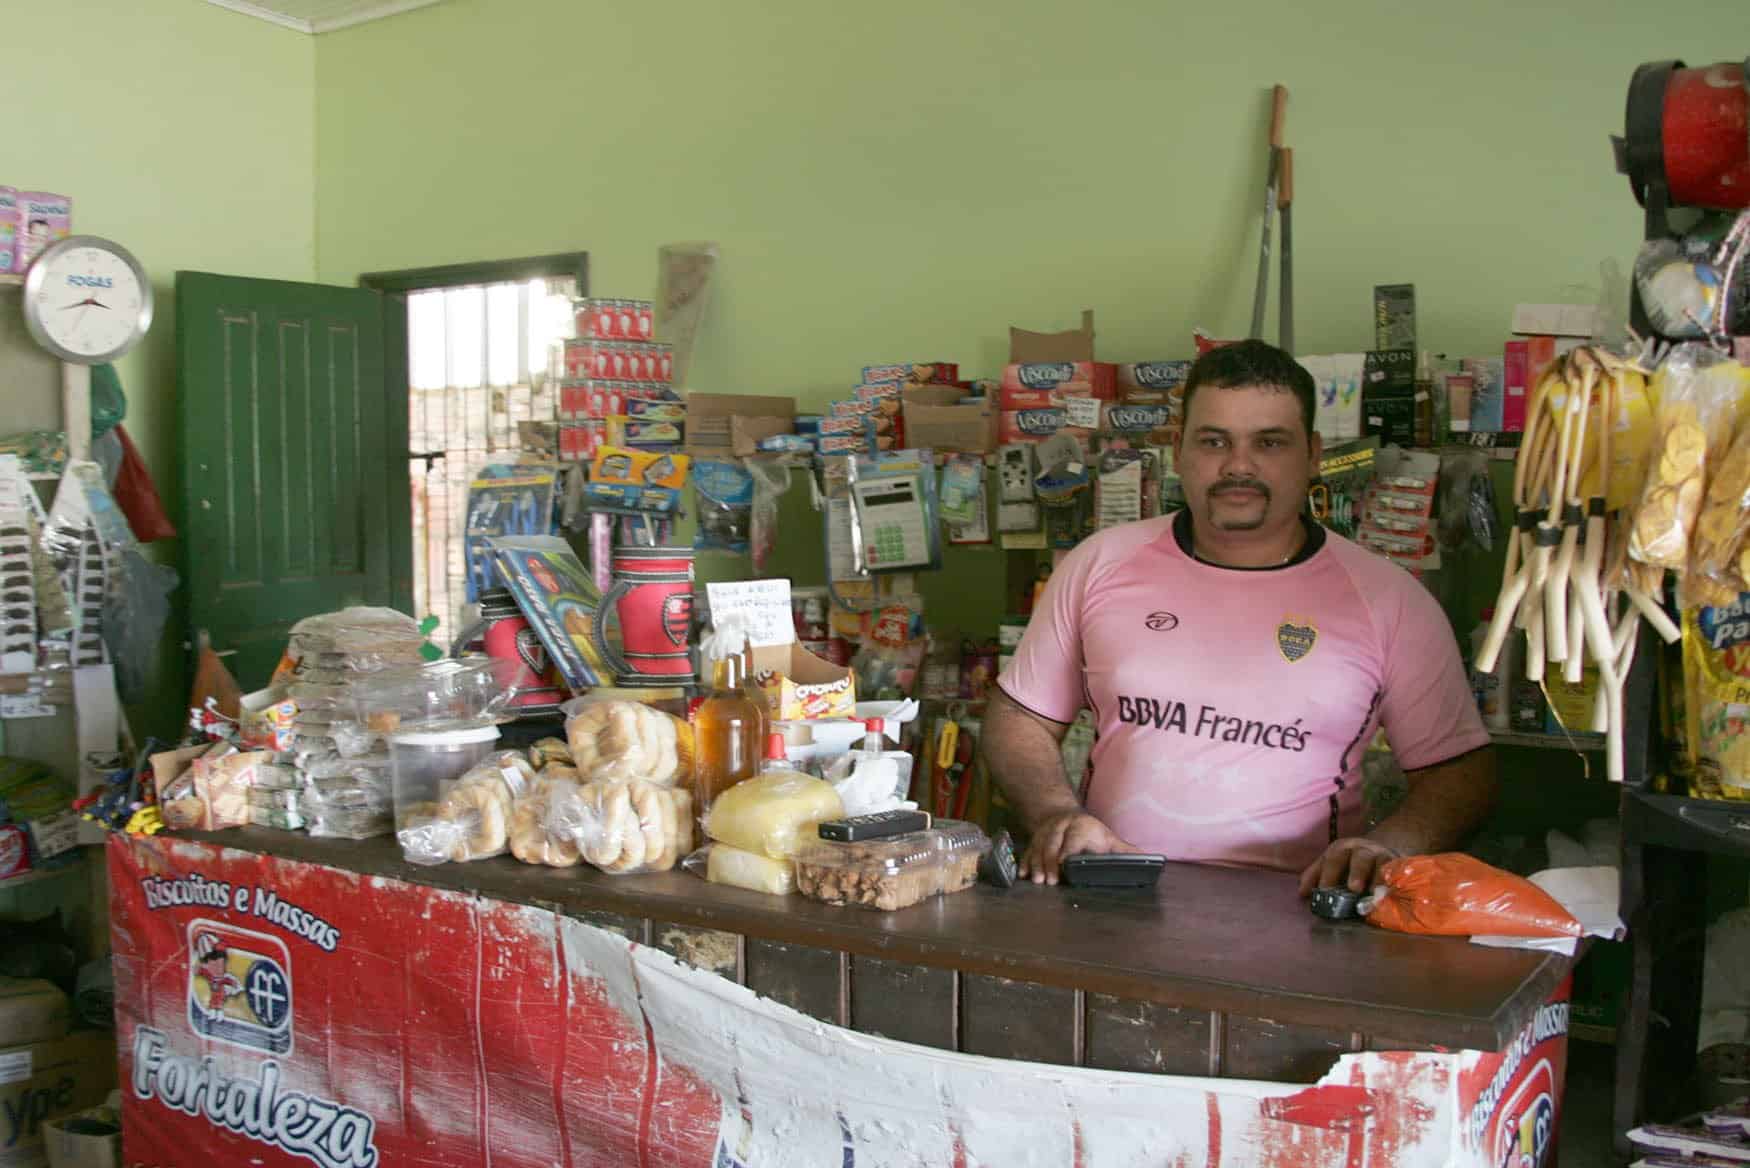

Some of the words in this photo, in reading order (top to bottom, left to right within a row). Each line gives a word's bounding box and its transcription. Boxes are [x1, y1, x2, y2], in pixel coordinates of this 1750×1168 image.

[1366, 352, 1412, 363] AVON
[1118, 695, 1187, 735] BBVA
[1194, 705, 1312, 753] Francés
[142, 872, 230, 909] Biscoitos
[234, 887, 250, 913] e
[253, 887, 341, 952] Massas
[134, 1025, 380, 1168] Fortaleza
